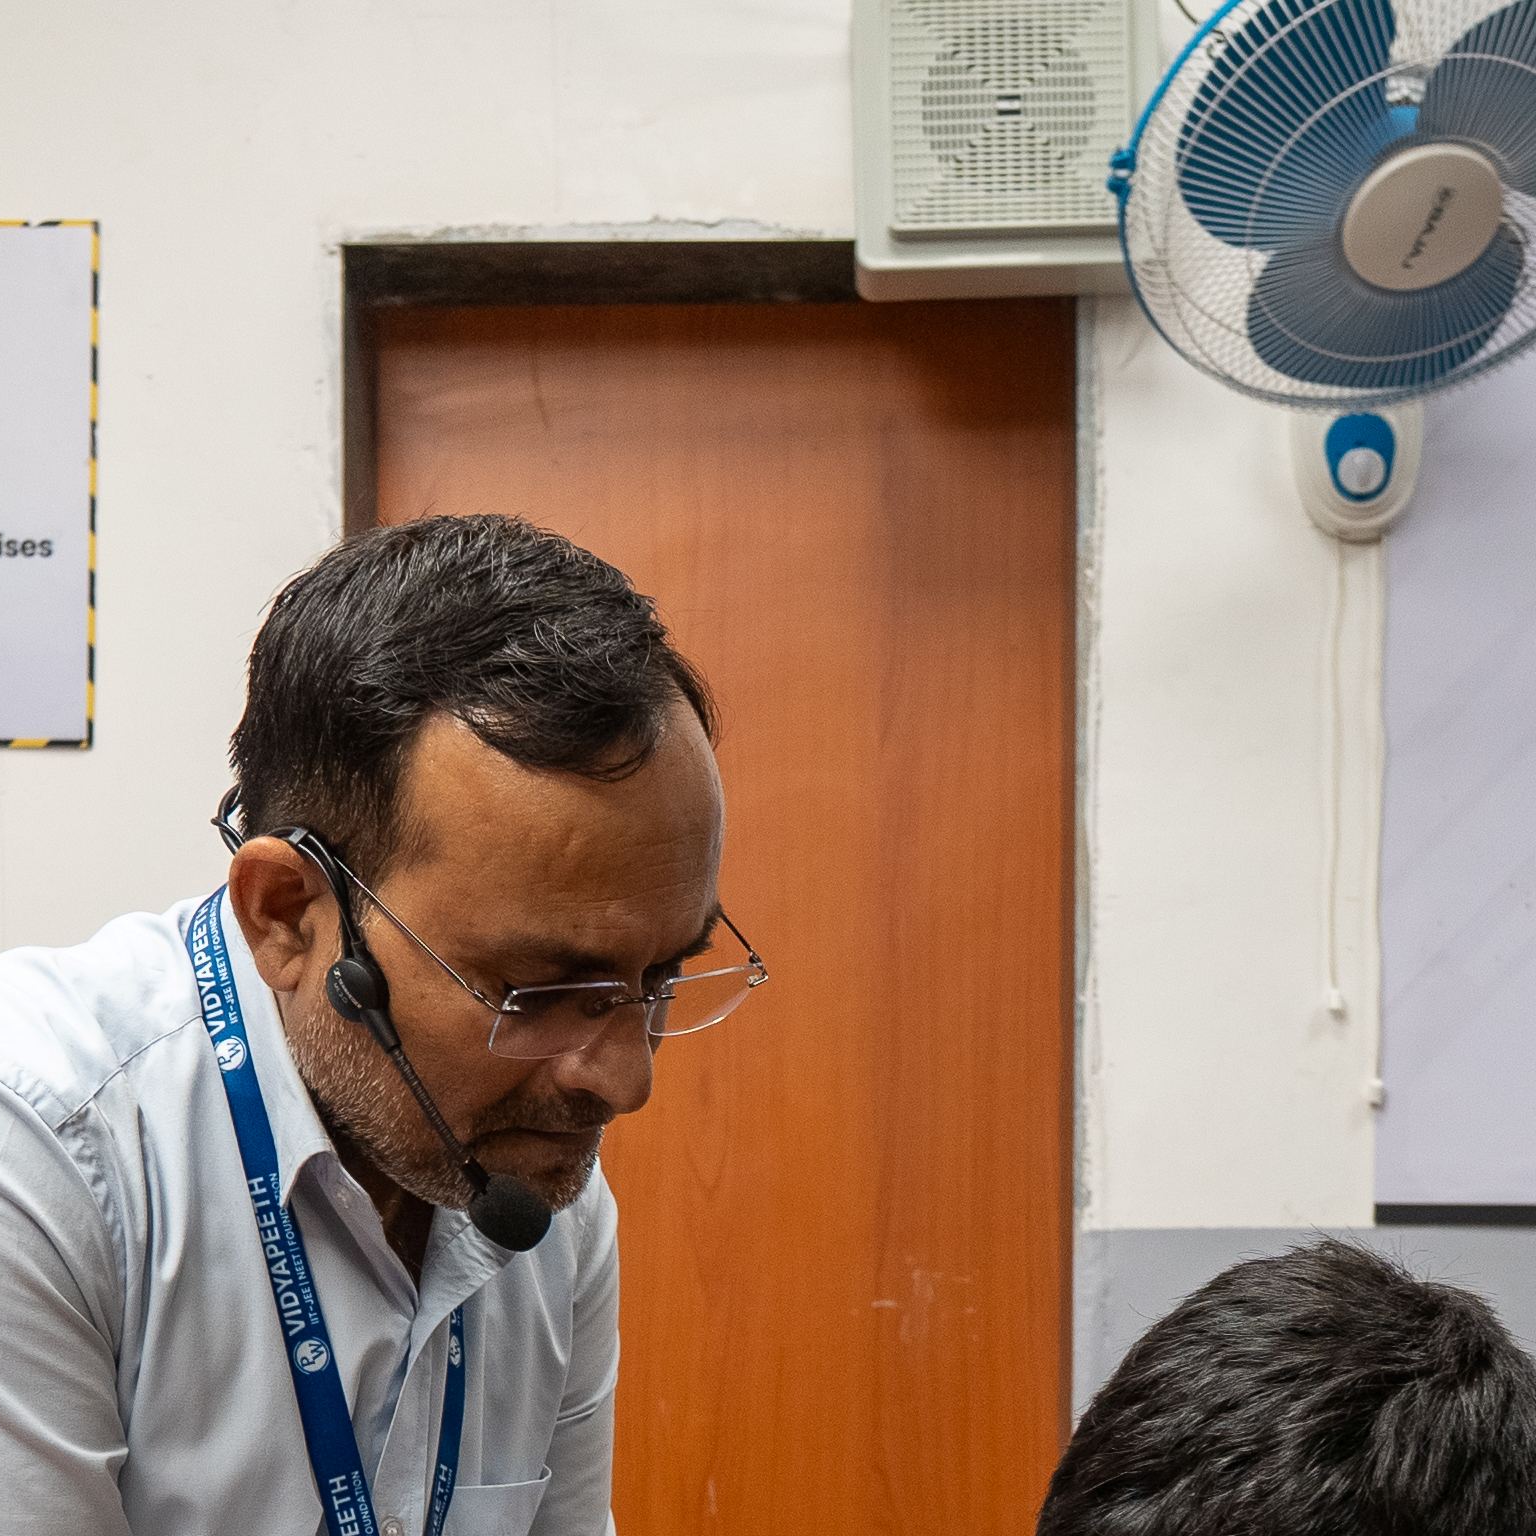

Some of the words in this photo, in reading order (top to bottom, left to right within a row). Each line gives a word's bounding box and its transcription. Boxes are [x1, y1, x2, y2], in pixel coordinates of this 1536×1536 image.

[192, 901, 226, 1037] VIDYAPEETH
[216, 956, 229, 982] NEET
[248, 1176, 306, 1337] VIDYAPEETH
[291, 1254, 307, 1281] NEET
[303, 1287, 320, 1324] IIT-JEE
[298, 1341, 326, 1370] PW
